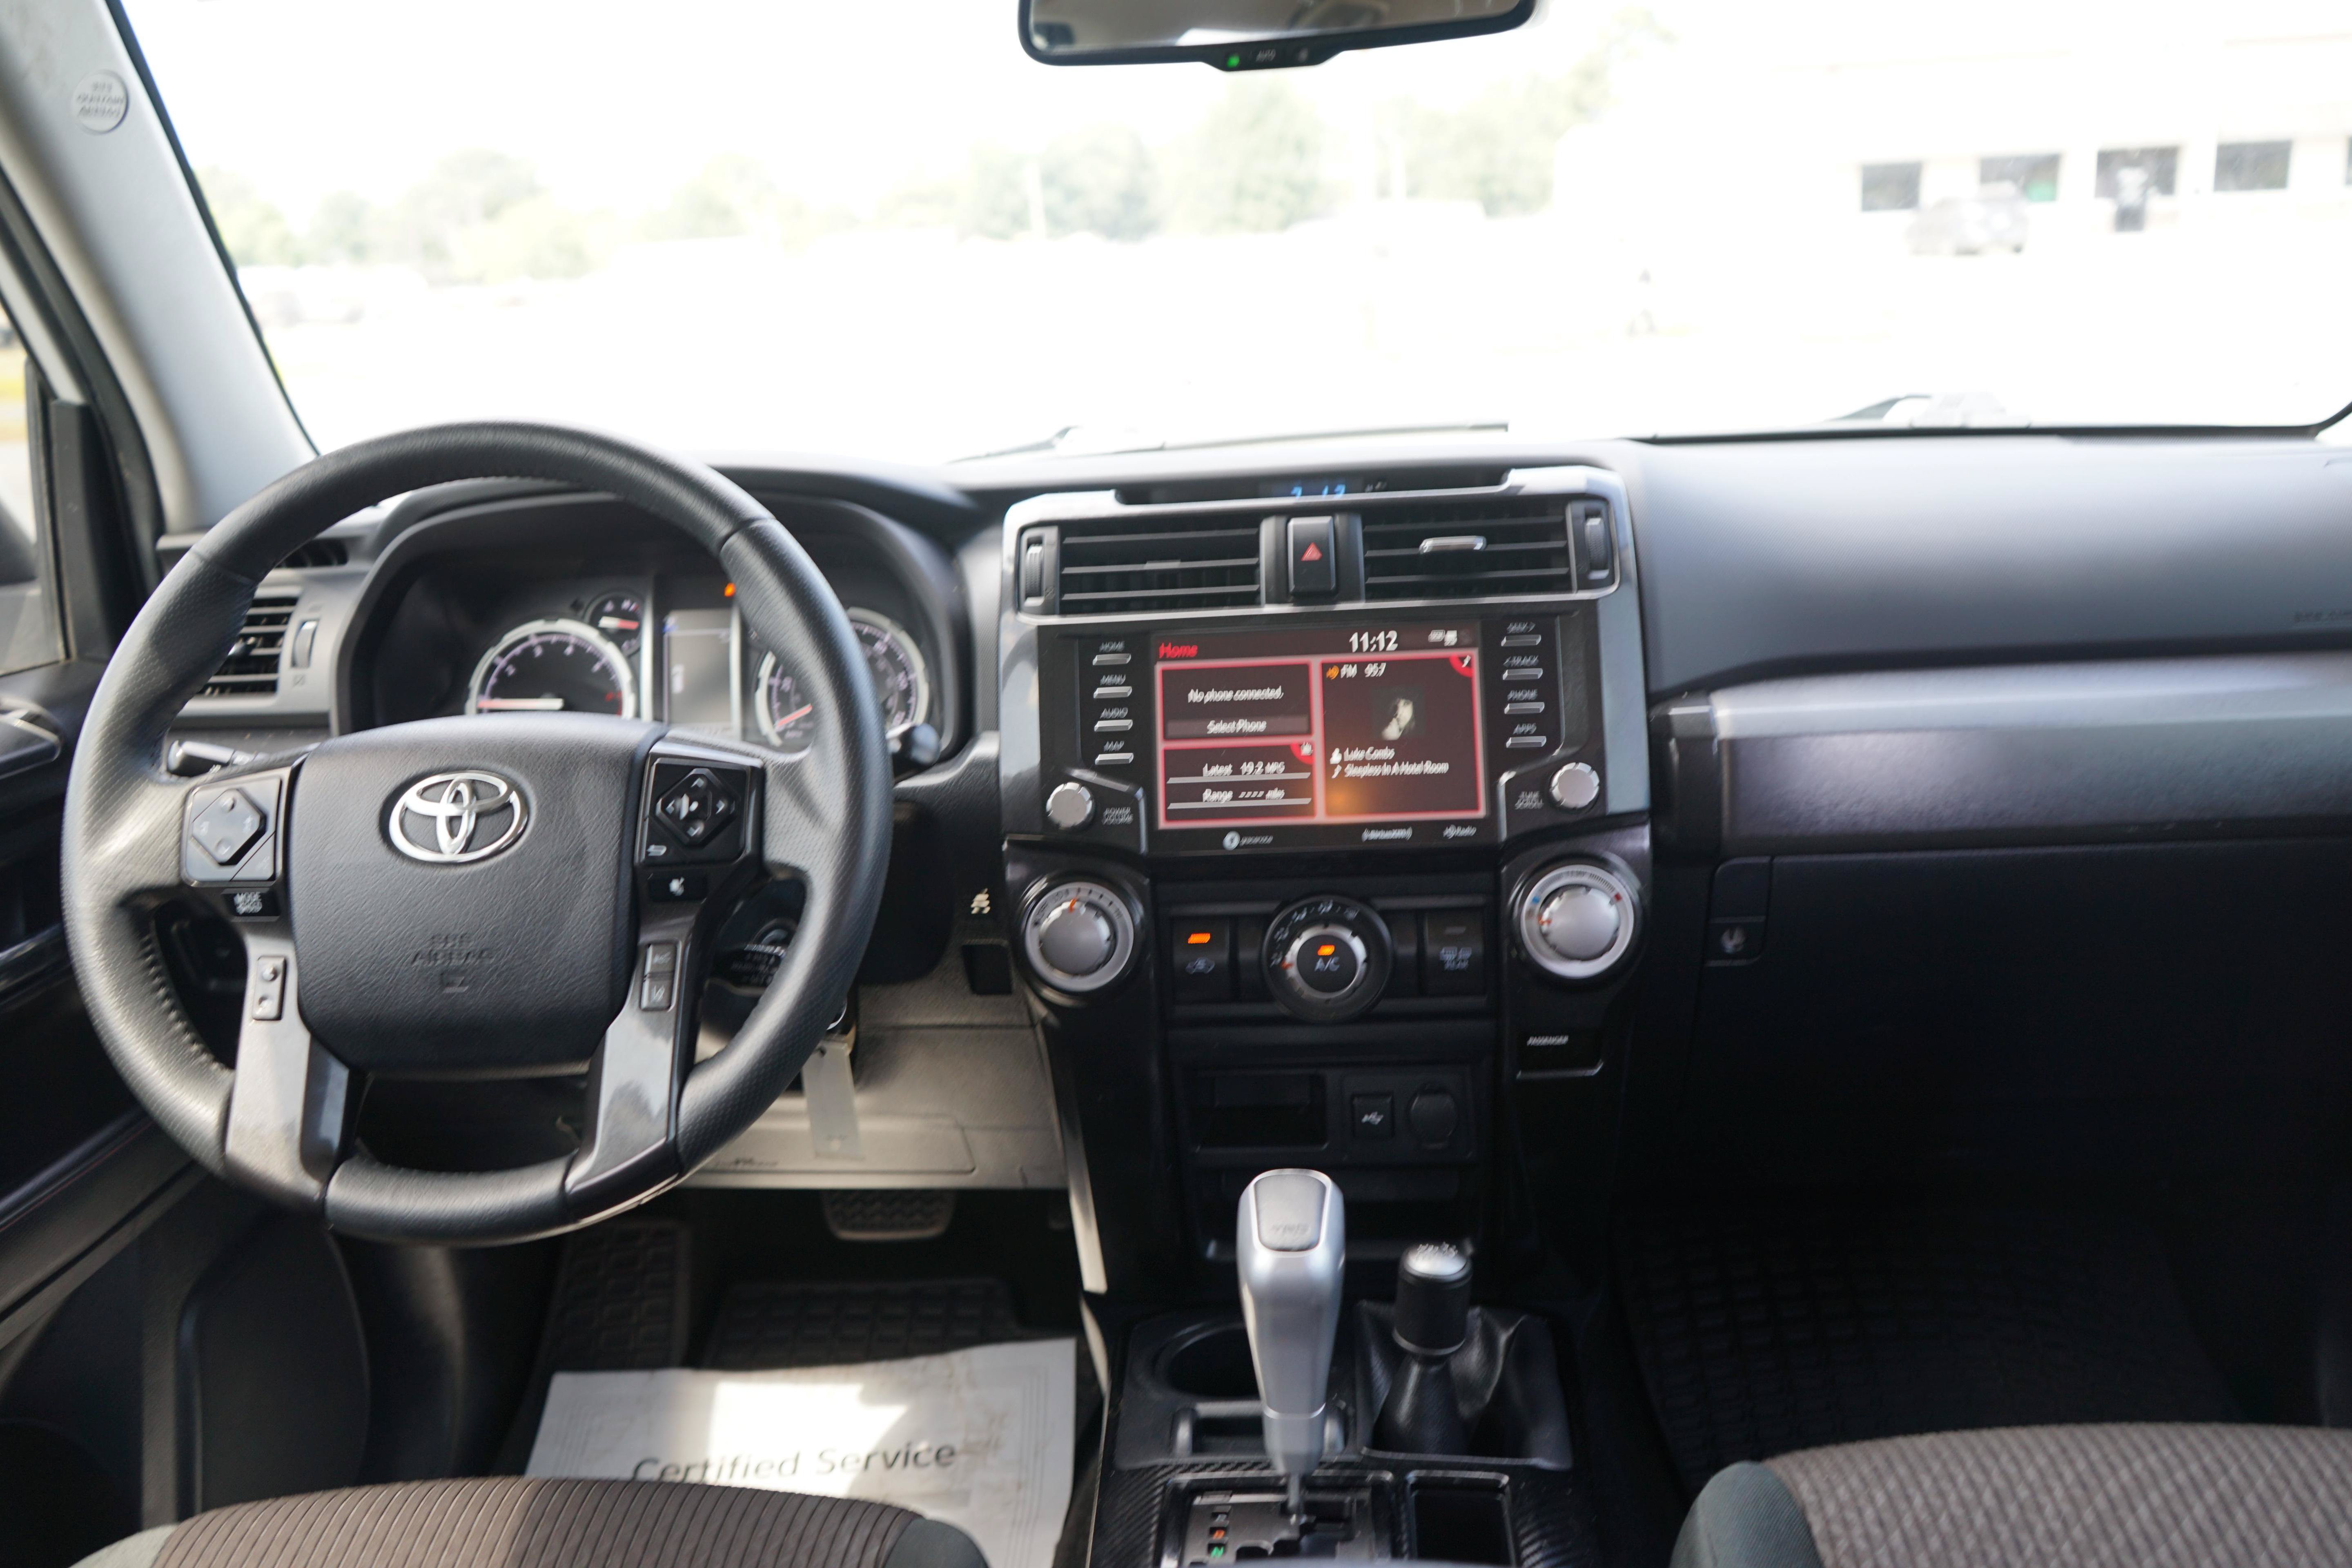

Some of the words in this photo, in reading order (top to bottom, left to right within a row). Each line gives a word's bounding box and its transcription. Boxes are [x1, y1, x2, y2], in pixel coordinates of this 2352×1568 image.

[1349, 630, 1399, 653] 11:12
[1158, 642, 1198, 658] Home
[1340, 664, 1357, 678] FM
[1100, 674, 1126, 685] MENU
[1188, 688, 1205, 703] No
[1204, 688, 1234, 704] phone
[1100, 707, 1128, 719] AUDIO
[1207, 719, 1236, 734] Select
[1236, 719, 1267, 733] Phone
[1344, 747, 1366, 761] Luke
[1365, 746, 1395, 760] Combs
[1203, 763, 1233, 776] Latest
[1240, 761, 1264, 775] 19.2
[1265, 762, 1285, 774] MPG
[1344, 763, 1382, 778] Sleepless
[1399, 761, 1423, 775] Hotel
[1423, 760, 1449, 774] Room
[1203, 788, 1233, 804] Range
[1265, 787, 1285, 800] miles
[1314, 956, 1340, 972] A/C
[1527, 1036, 1569, 1046] PASSENGER
[634, 1450, 801, 1483] Certified
[817, 1443, 957, 1474] Service
